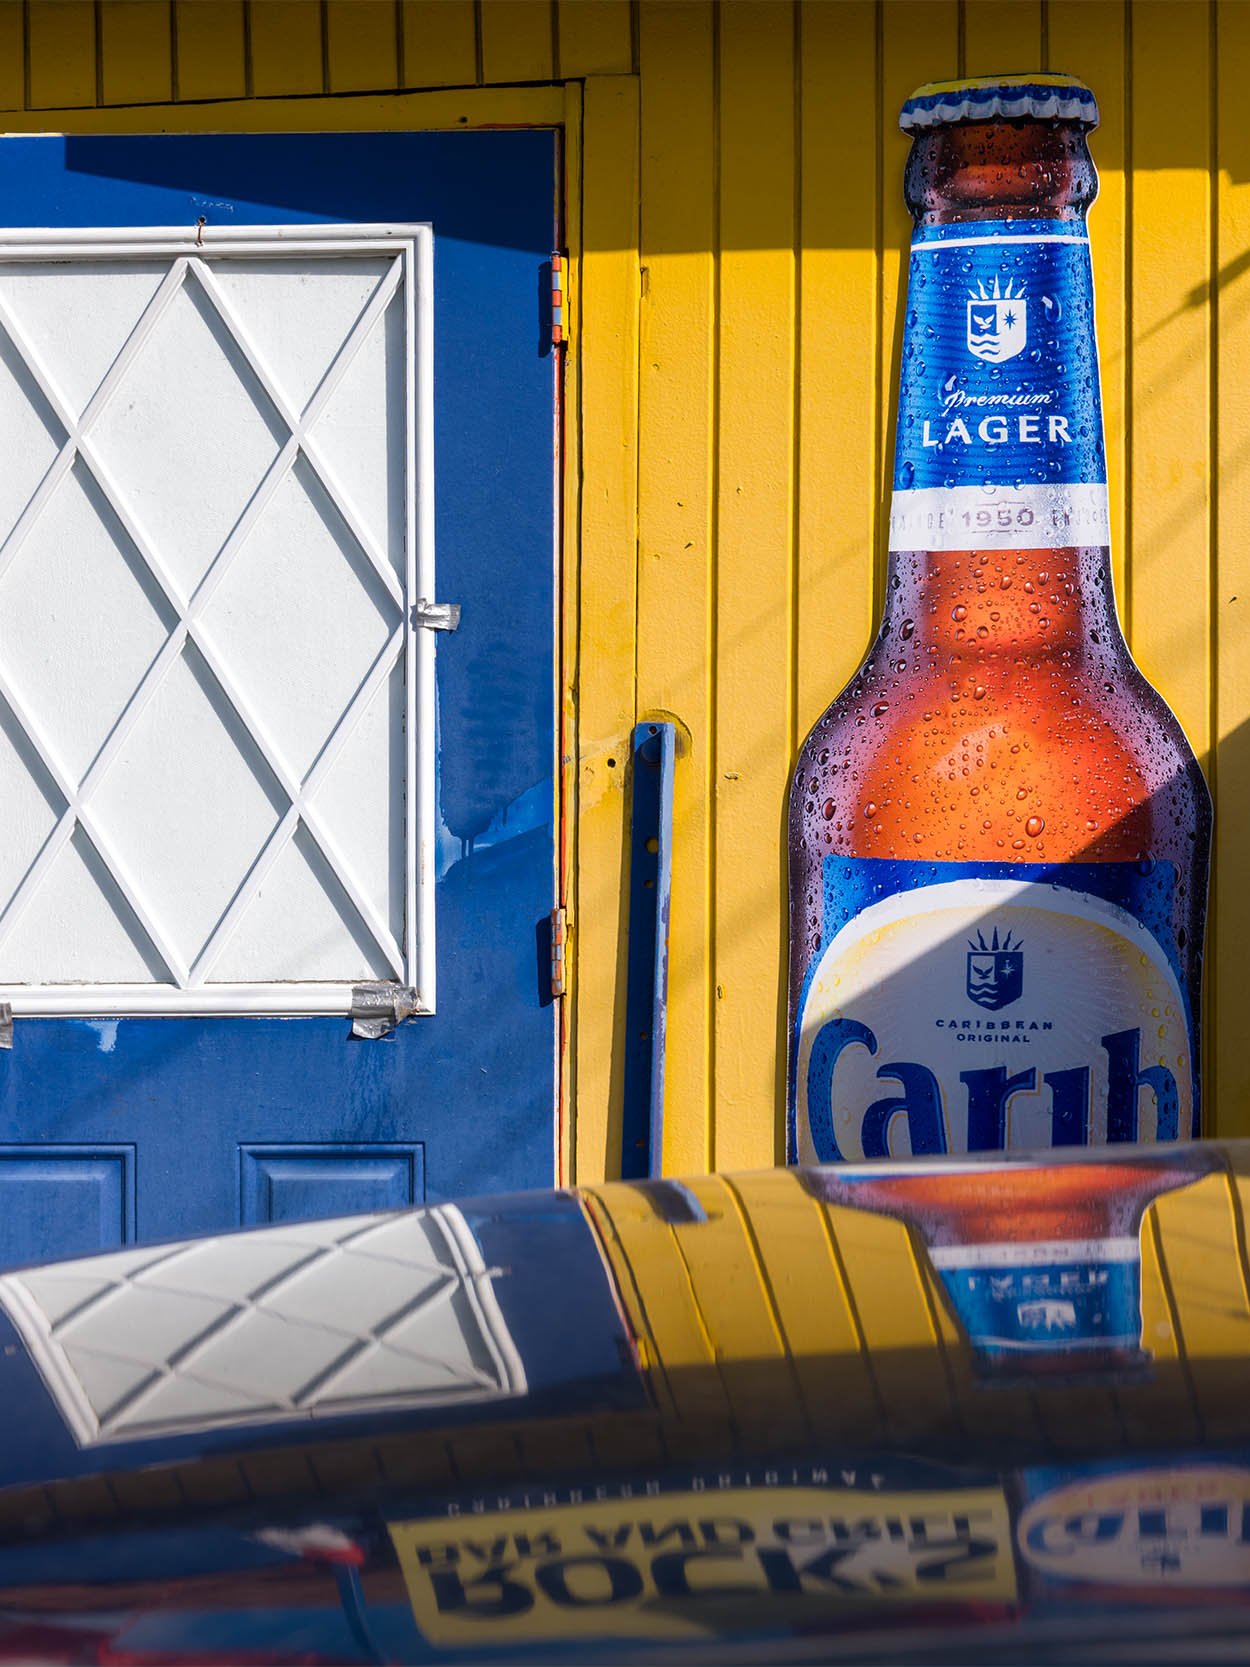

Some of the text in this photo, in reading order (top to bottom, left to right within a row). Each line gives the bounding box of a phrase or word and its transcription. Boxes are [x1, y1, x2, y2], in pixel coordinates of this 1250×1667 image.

[922, 415, 1072, 447] LAGER
[961, 507, 1035, 528] 1950
[935, 1019, 1053, 1030] CARIBBEAN
[956, 1033, 1031, 1043] ORIGINAL
